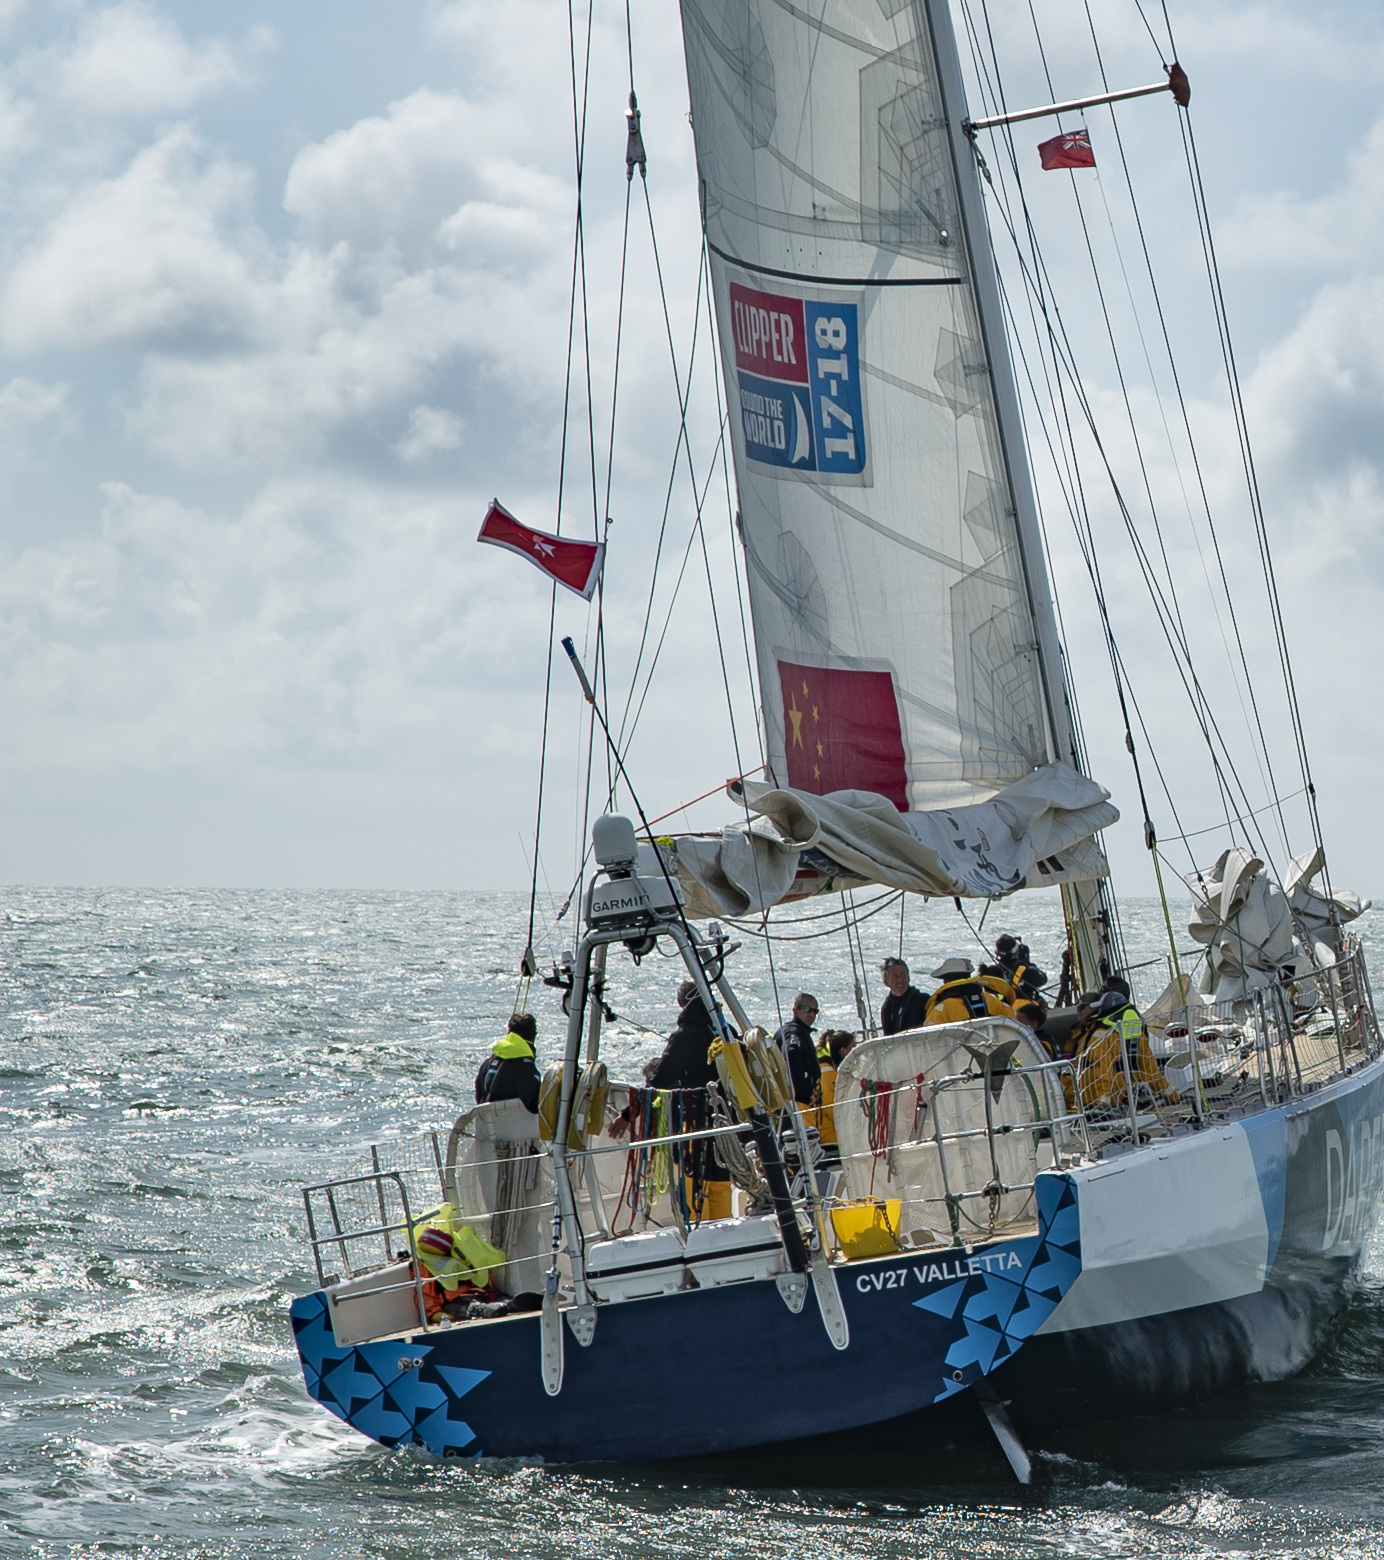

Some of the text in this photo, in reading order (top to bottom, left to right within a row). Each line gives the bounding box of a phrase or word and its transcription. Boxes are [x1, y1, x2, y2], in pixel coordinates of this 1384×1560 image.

[734, 299, 797, 365] CLIPPER
[764, 396, 784, 419] THE
[814, 316, 856, 460] 17-18
[855, 1251, 1023, 1293] CV27 VALLETTA
